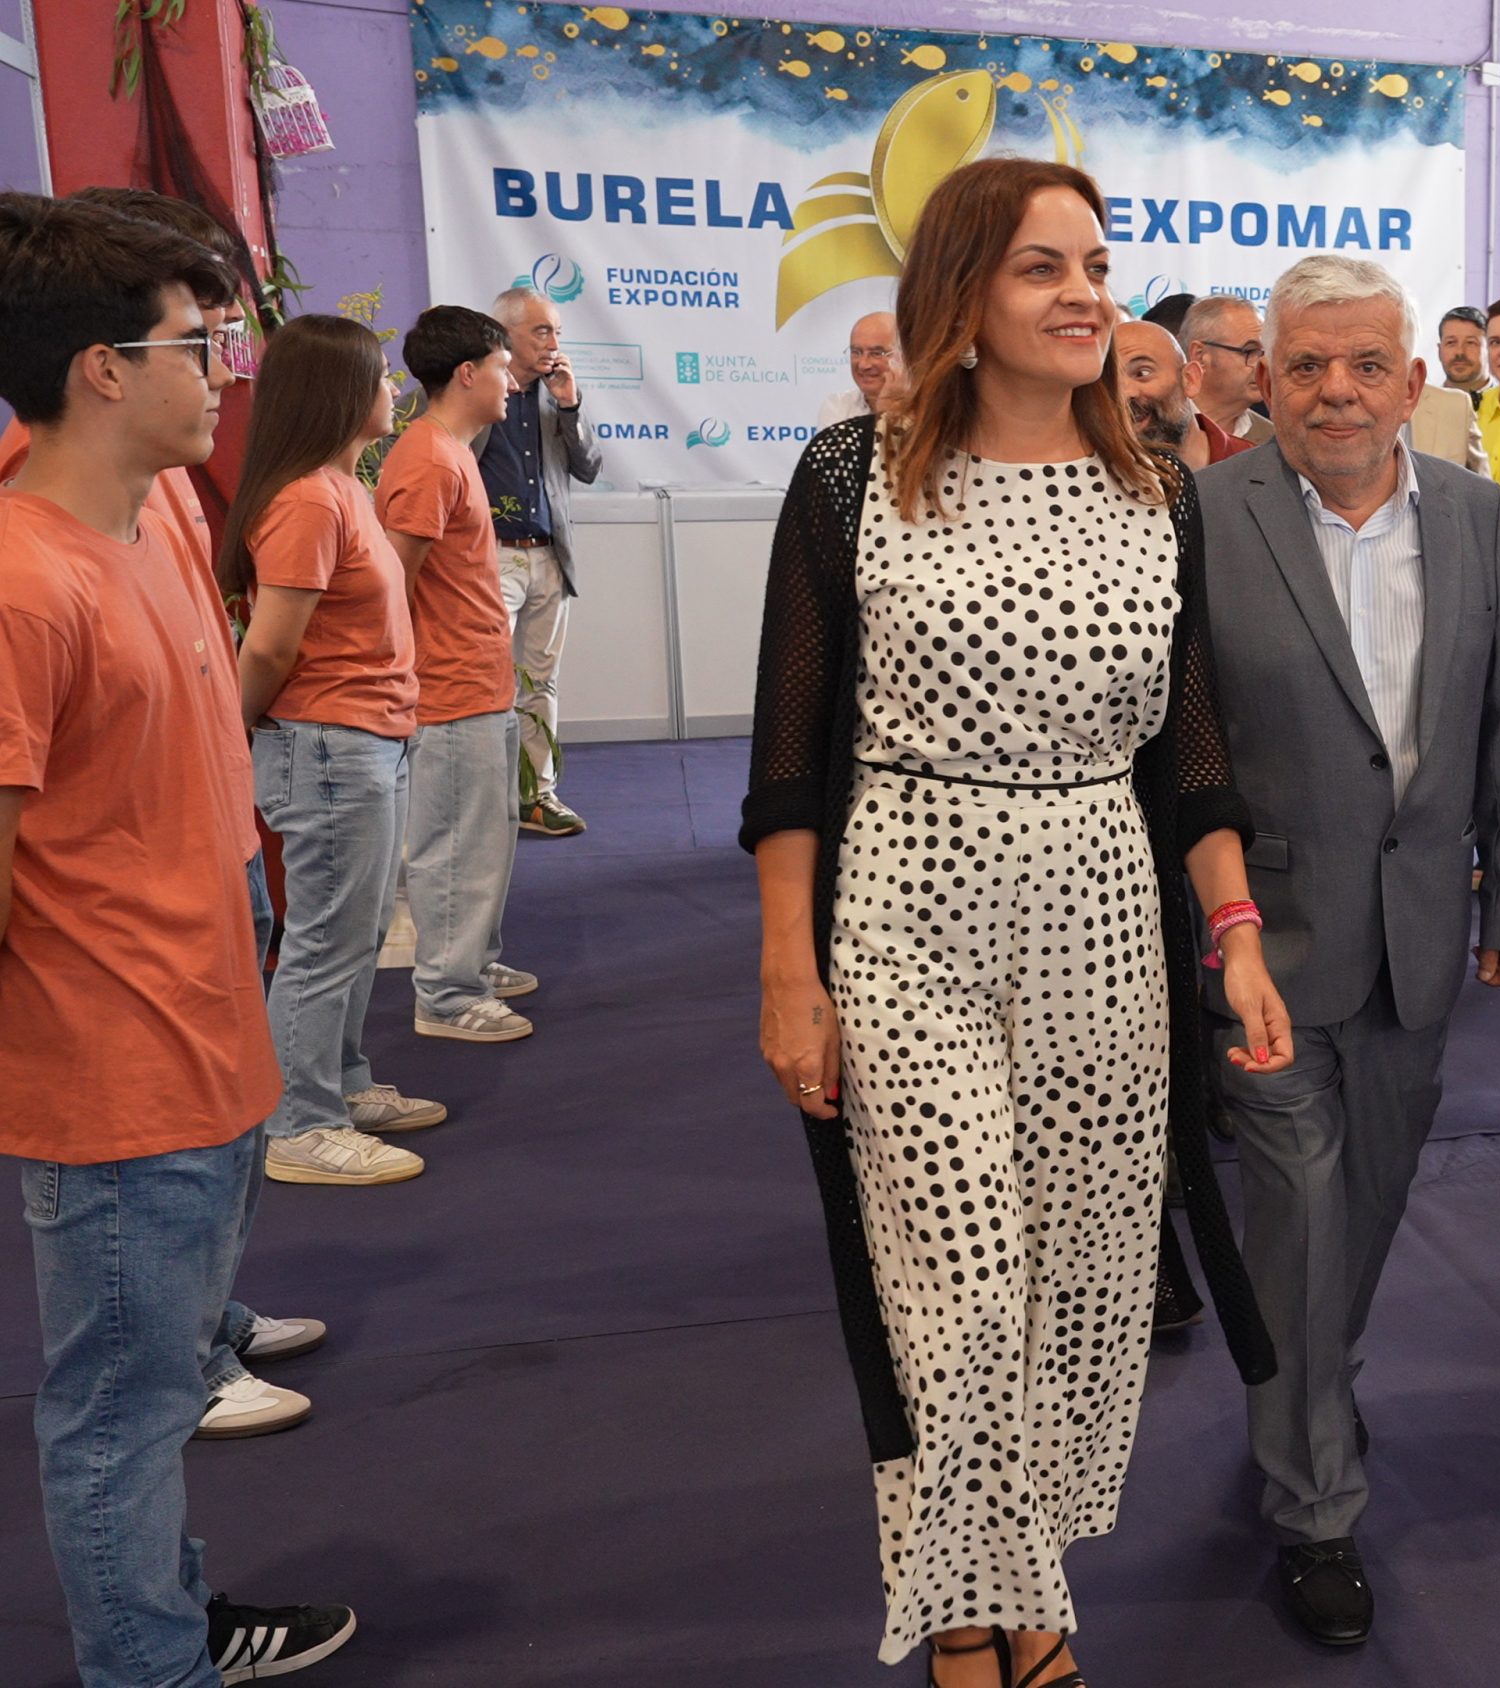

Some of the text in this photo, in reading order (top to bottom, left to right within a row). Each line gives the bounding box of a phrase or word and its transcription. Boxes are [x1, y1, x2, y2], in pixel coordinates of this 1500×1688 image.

[493, 167, 795, 231] BURELA
[1104, 196, 1412, 252] EXPOMAR
[606, 267, 739, 288] FUNDACIÓN
[608, 289, 740, 309] EXPOMAR
[705, 355, 757, 367] XUNTA
[705, 370, 790, 383] DE GALICIA
[592, 423, 669, 440] OMAR
[747, 426, 819, 441] EXPO
